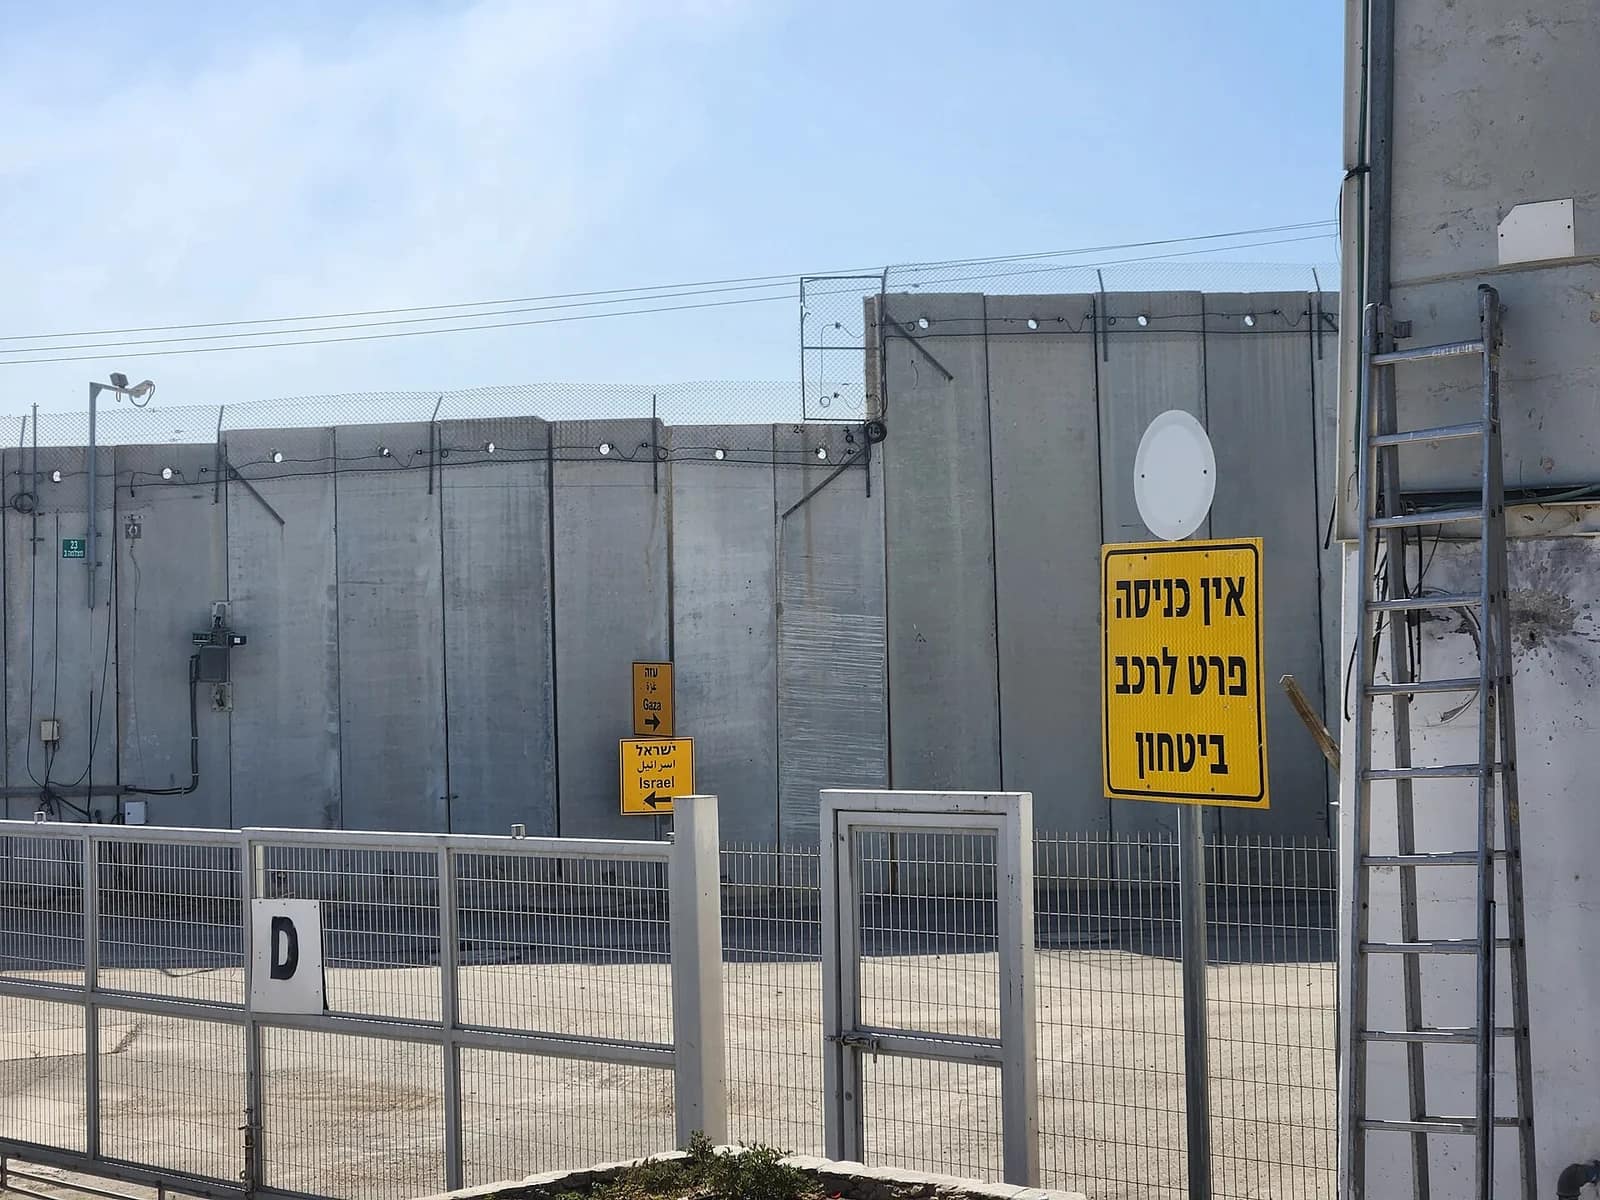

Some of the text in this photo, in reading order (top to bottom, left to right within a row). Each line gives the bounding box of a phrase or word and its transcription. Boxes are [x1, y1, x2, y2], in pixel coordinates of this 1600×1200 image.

[70, 540, 78, 549] 23
[1115, 576, 1246, 626] אין כניסה
[644, 667, 658, 678] עזה
[1115, 647, 1247, 696] פרט לרכב
[646, 681, 657, 694] غزة
[643, 699, 662, 711] Gaza
[635, 744, 677, 757] ישראל
[1135, 732, 1229, 779] ביטחון
[639, 775, 675, 789] Israel
[270, 916, 299, 980] D
